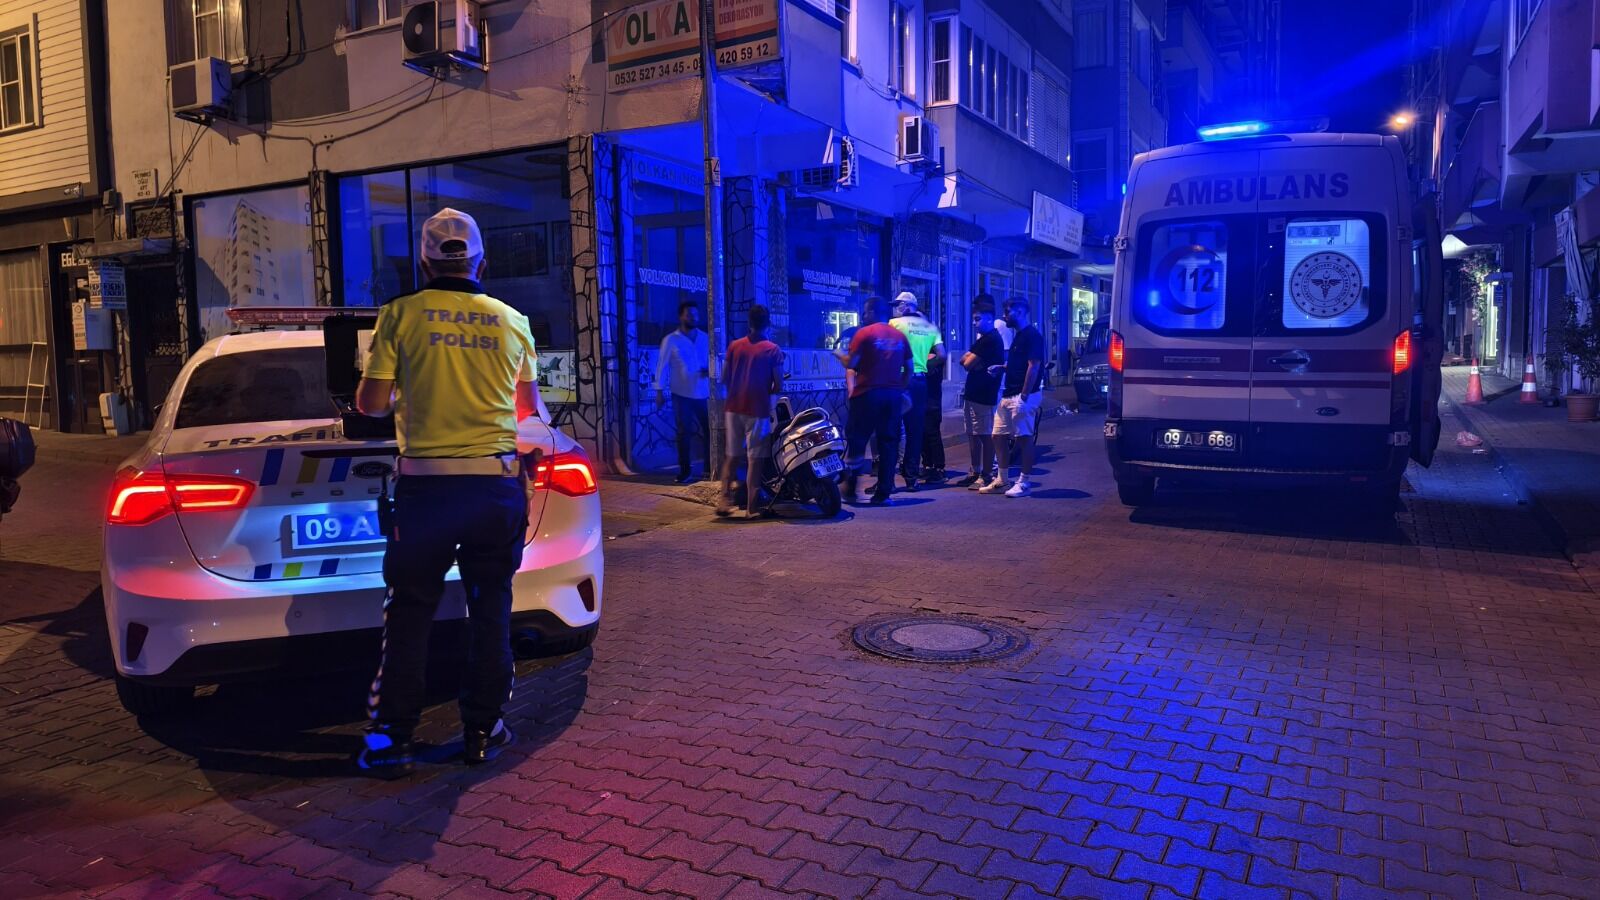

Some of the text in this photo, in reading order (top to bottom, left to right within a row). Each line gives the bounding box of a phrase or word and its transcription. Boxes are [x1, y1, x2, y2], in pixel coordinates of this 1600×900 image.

[719, 42, 769, 64] 420 59 12
[615, 70, 637, 86] 0532
[639, 66, 656, 81] 527
[658, 64, 670, 77] 34
[672, 61, 685, 75] 45
[1164, 173, 1349, 207] AMBULANS
[638, 267, 680, 287] VOLKAN
[1177, 267, 1216, 293] 112
[1164, 432, 1180, 445] 09
[1208, 434, 1233, 448] 668
[291, 487, 381, 498] FOC
[305, 518, 342, 540] 09
